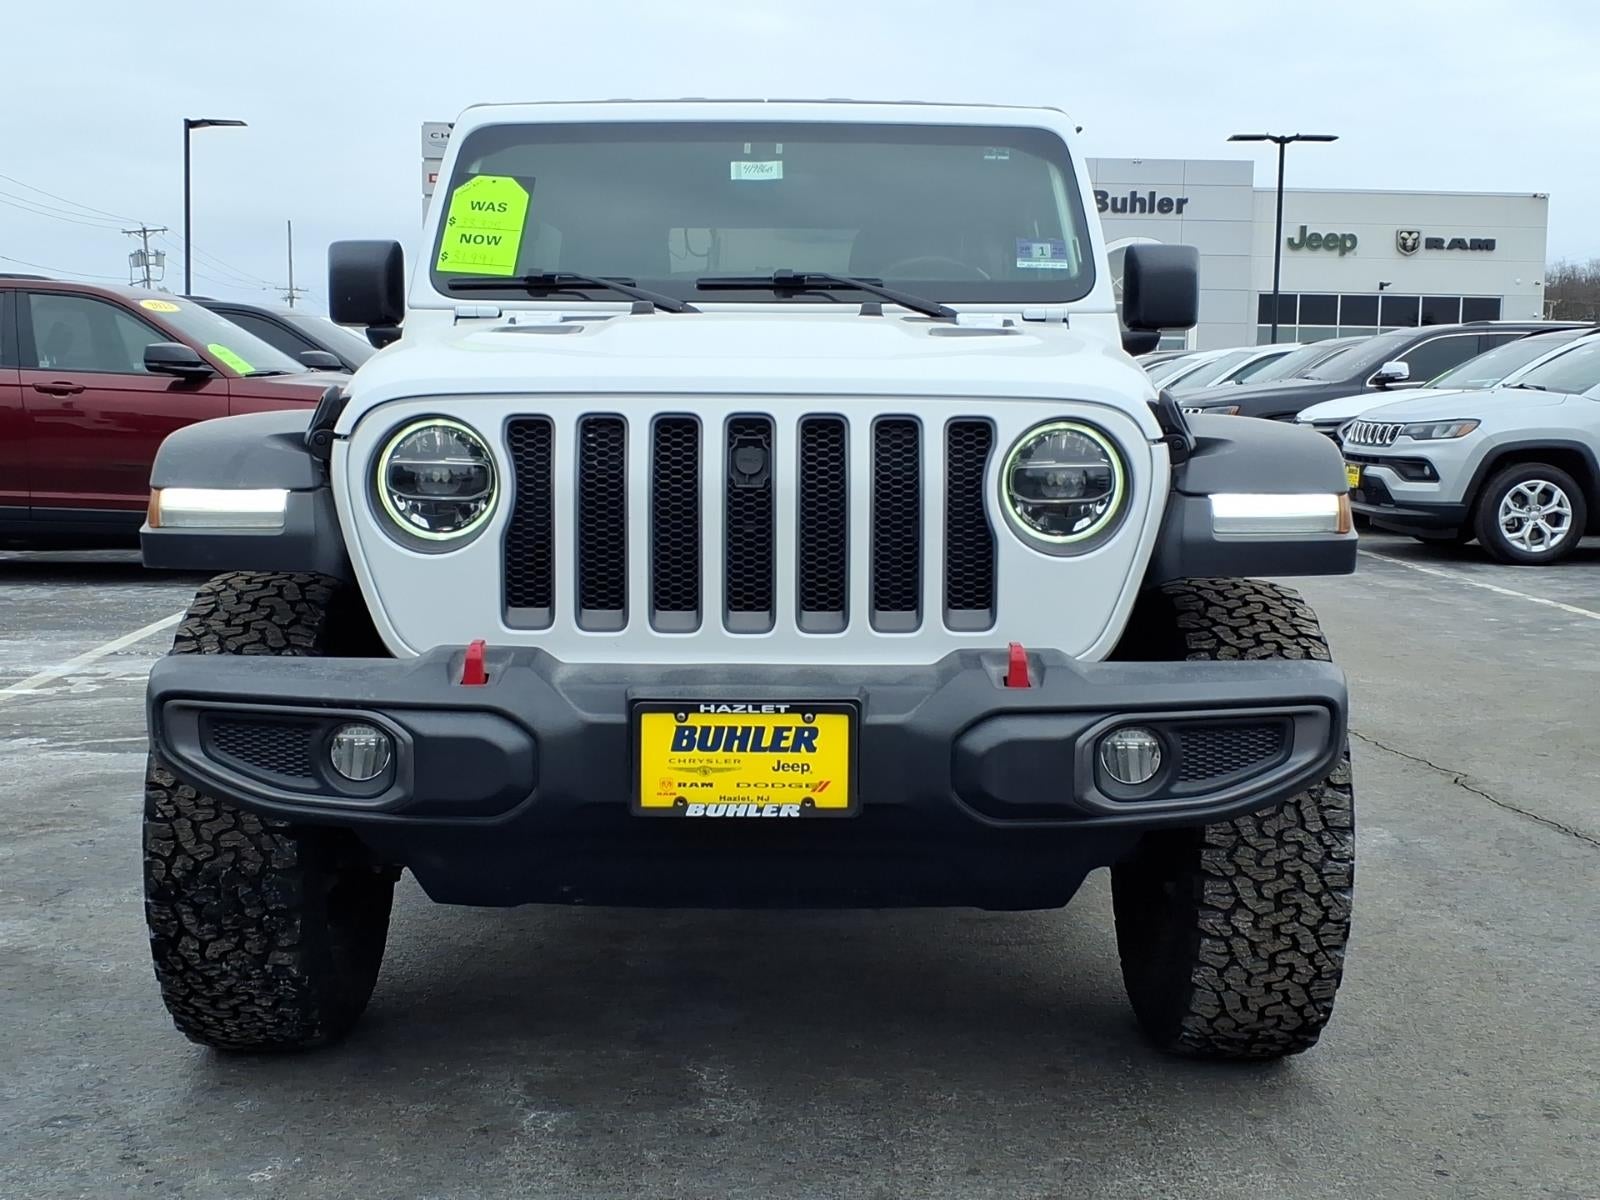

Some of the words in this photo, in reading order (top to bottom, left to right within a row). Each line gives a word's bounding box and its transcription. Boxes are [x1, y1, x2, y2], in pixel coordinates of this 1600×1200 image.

[470, 200, 508, 213] WAS
[1093, 190, 1189, 215] Buhler
[448, 216, 457, 227] $
[459, 233, 503, 246] NOW
[1287, 225, 1358, 257] Jeep
[1425, 237, 1496, 251] RAM
[1039, 246, 1047, 257] 1
[699, 704, 790, 714] HAZLET
[671, 725, 820, 753] BUHLER
[772, 760, 811, 774] Jeep
[685, 803, 801, 818] BUHLER
